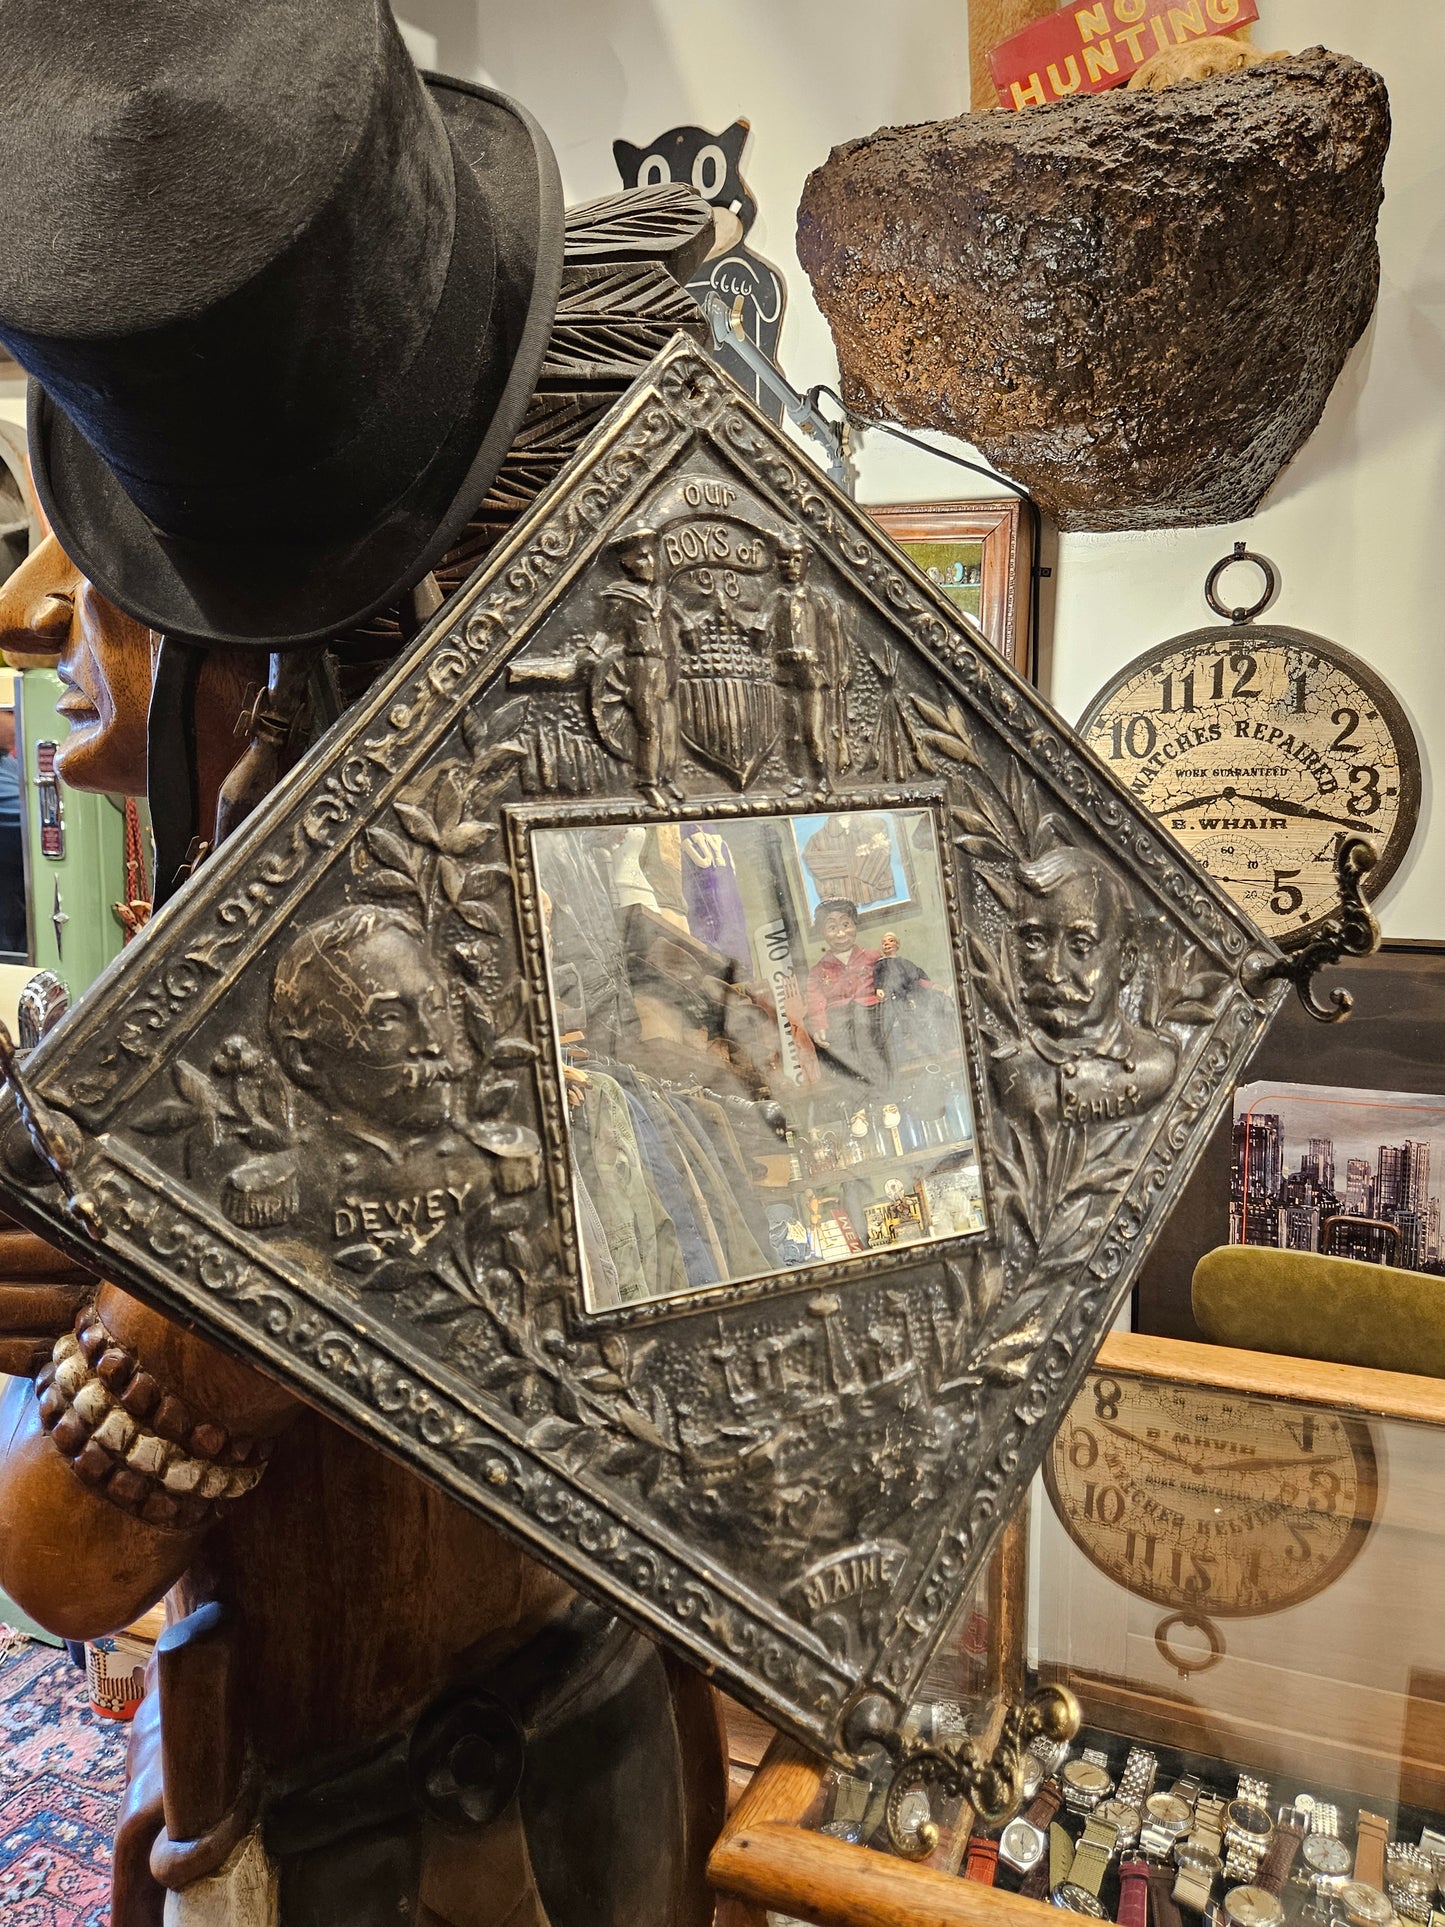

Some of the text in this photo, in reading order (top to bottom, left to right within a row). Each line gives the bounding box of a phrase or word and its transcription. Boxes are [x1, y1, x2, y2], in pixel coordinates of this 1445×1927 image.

[1074, 0, 1147, 43] NO
[1010, 0, 1240, 111] HUNTING
[667, 526, 765, 566] BOYS of
[1159, 672, 1195, 714] 11
[1209, 655, 1263, 699] 12
[1289, 672, 1307, 714] 1
[1108, 716, 1157, 760] 10
[1330, 708, 1361, 752] 2
[1130, 720, 1338, 796] WATCHES REPAIRED
[1175, 767, 1289, 778] WORK GUARANTEED
[1346, 765, 1380, 816] 3
[1269, 870, 1303, 915] 5
[335, 1182, 472, 1237] DEWEY
[803, 1551, 896, 1609] MAINE
